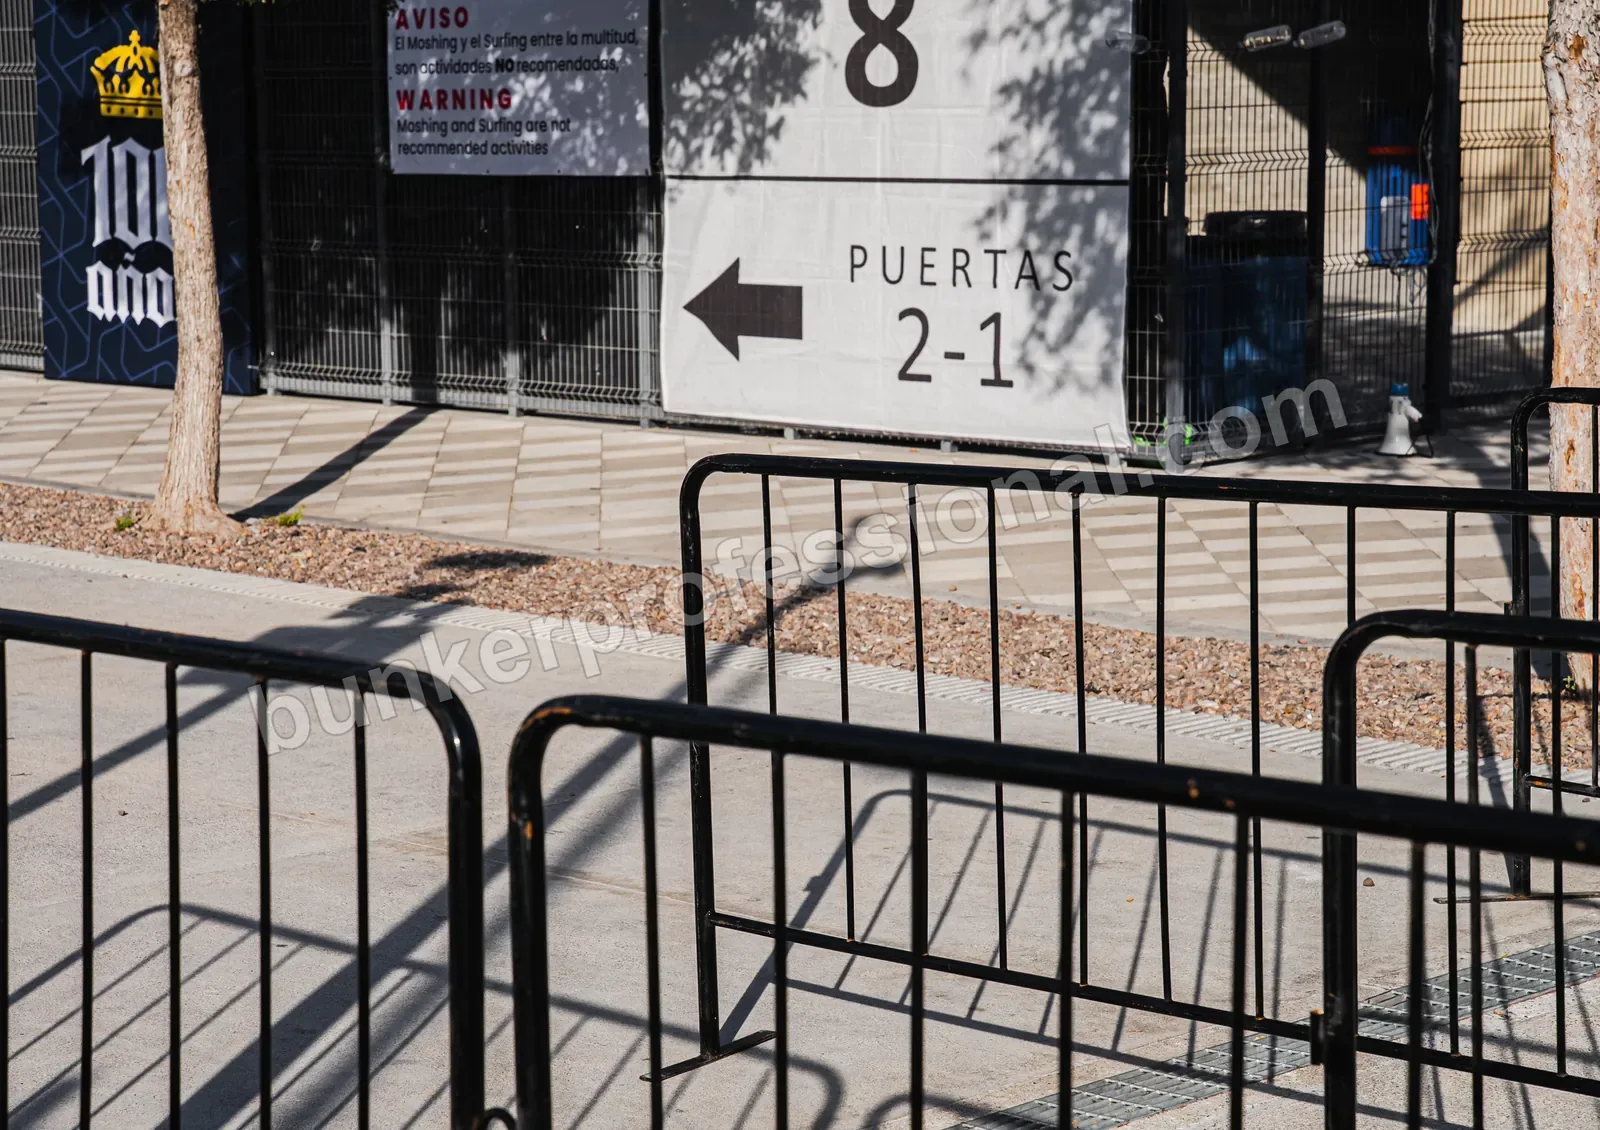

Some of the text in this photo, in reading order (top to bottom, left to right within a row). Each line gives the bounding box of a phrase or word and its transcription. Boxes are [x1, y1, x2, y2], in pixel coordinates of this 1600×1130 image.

[395, 6, 469, 30] AVISO
[395, 28, 639, 54] El Moshing y el Surfing entre la multitud,
[845, 0, 919, 107] 8
[395, 56, 620, 75] son actividades NO recomendadas,
[396, 88, 513, 111] WARNING
[397, 117, 571, 138] Moshing and Surfing are not
[397, 139, 549, 156] recommended activities
[849, 245, 1074, 292] PUERTAS
[85, 252, 178, 328] año
[897, 307, 1014, 389] 2-1
